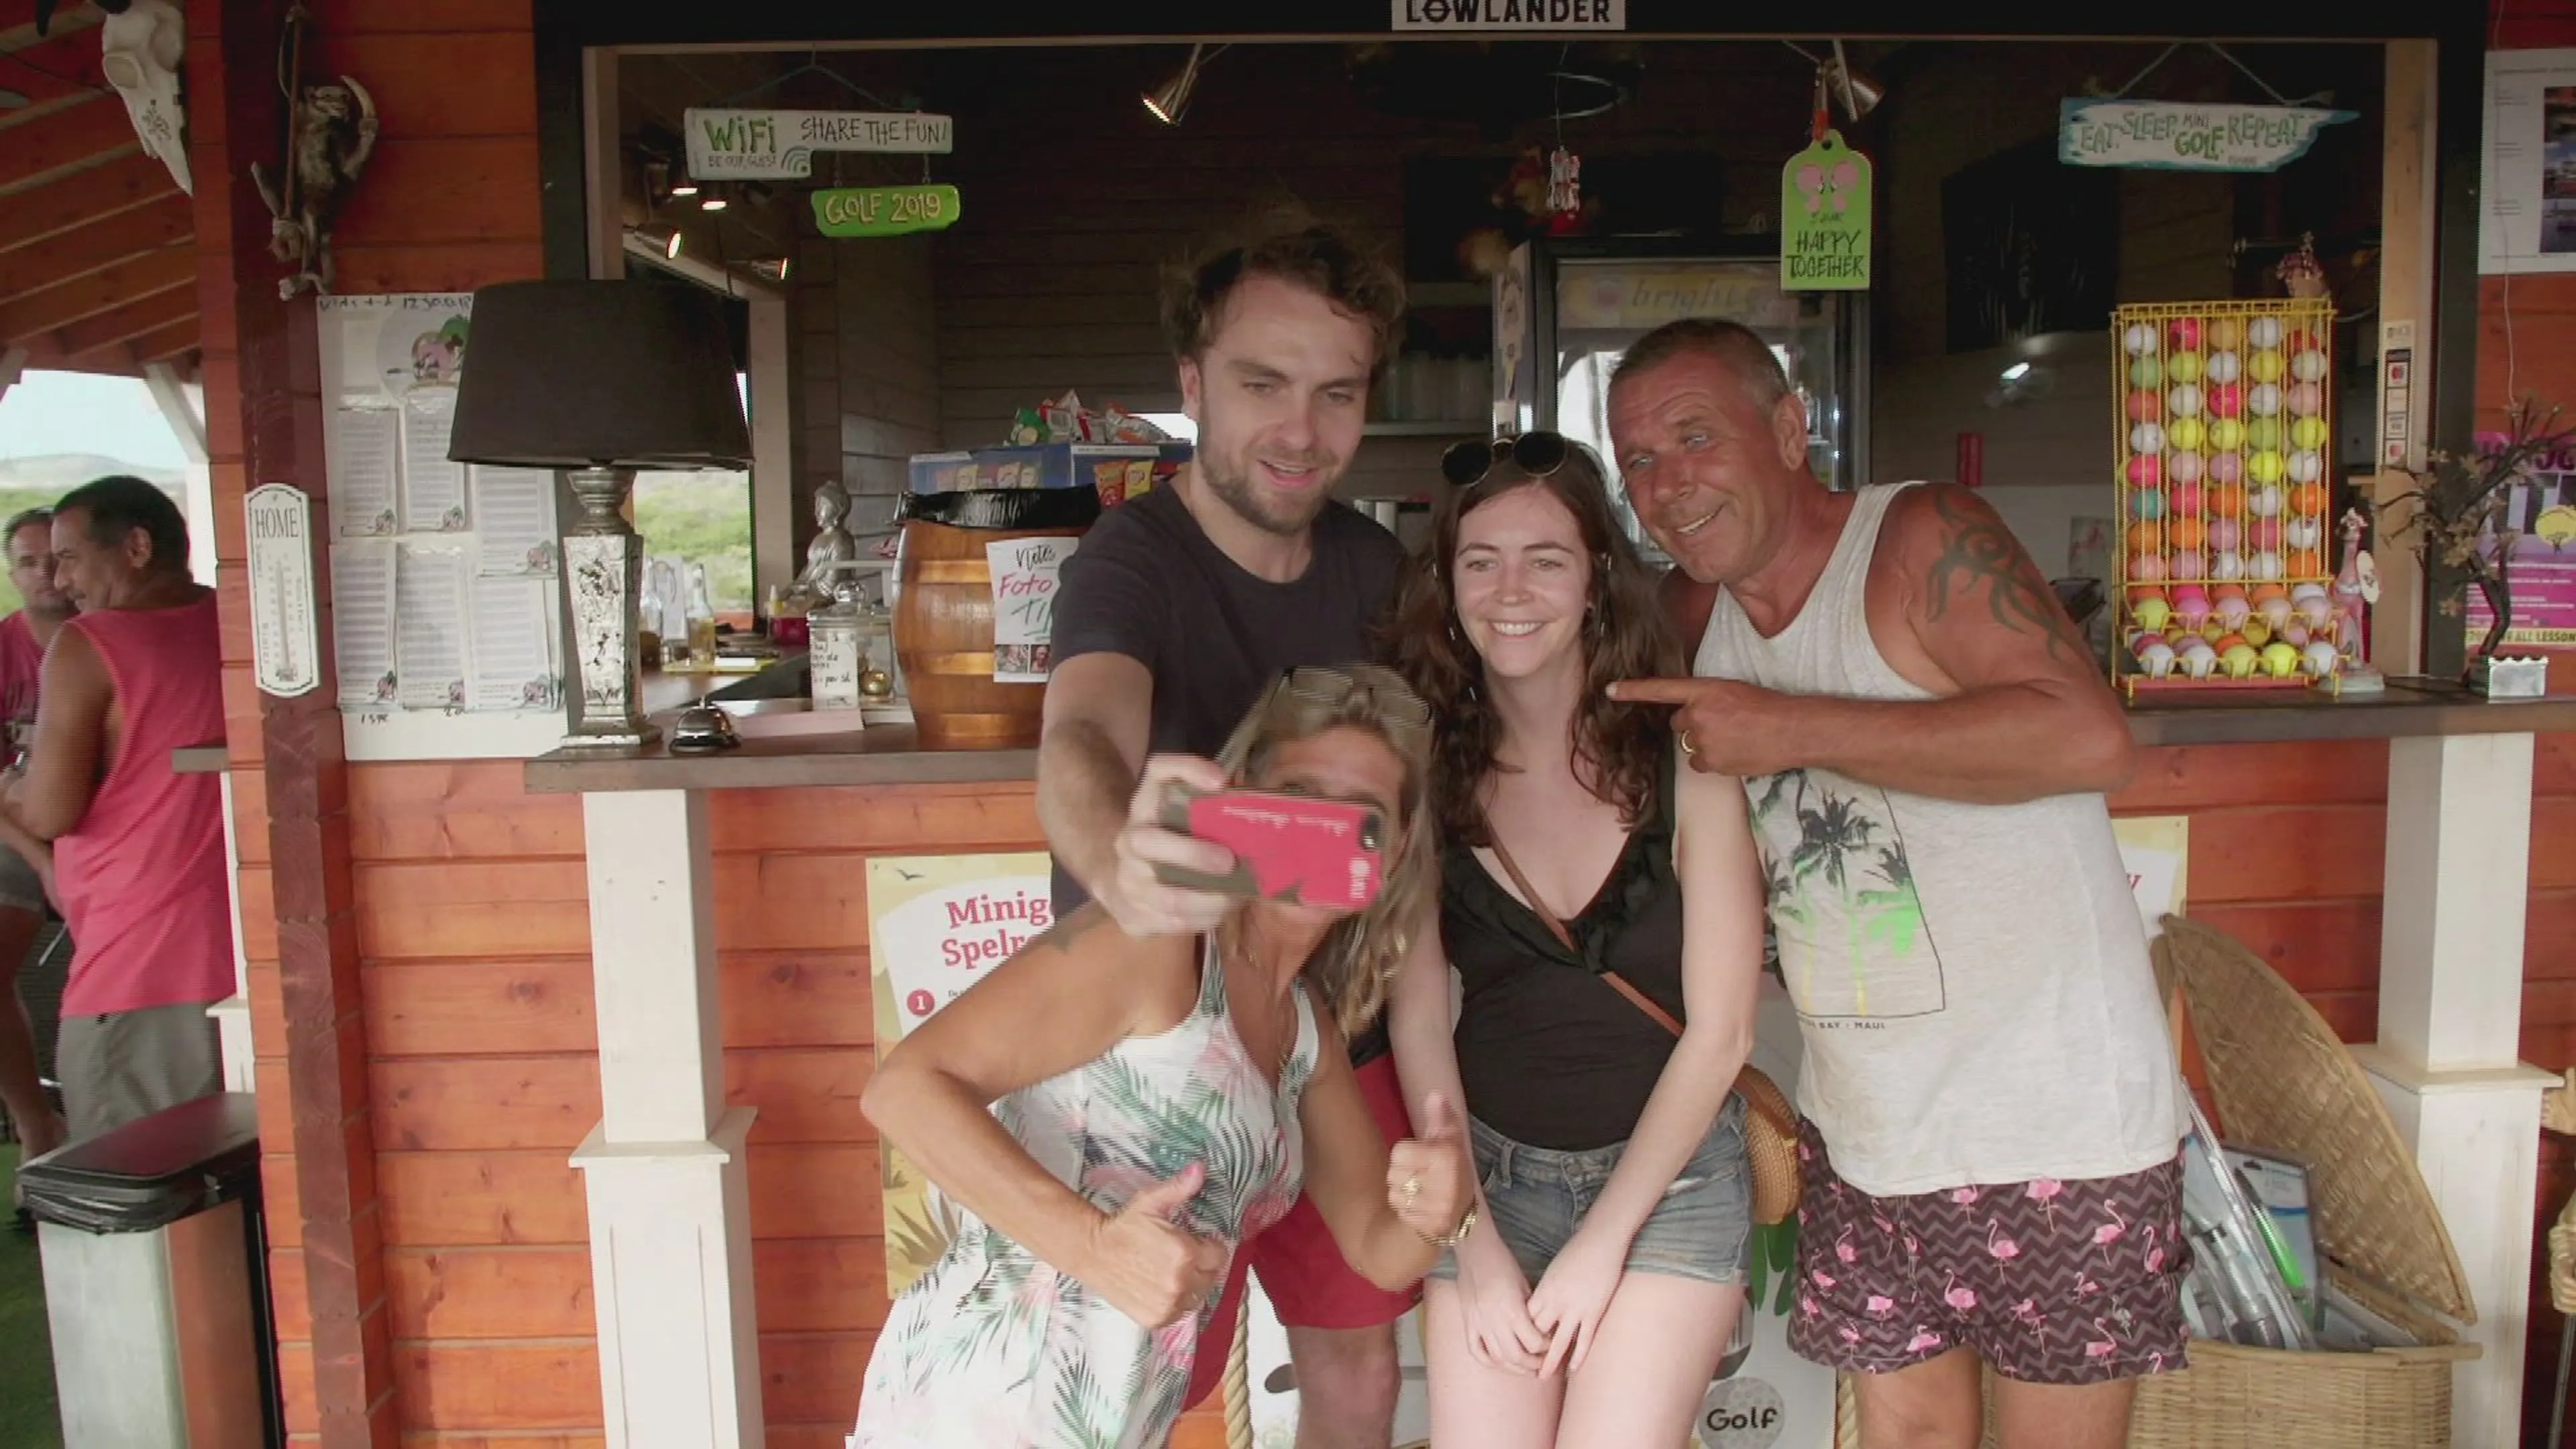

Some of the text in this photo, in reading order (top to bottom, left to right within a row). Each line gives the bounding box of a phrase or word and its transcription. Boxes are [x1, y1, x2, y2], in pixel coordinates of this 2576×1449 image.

[1406, 0, 1610, 23] LOWLANDER
[800, 117, 861, 143] SHARE
[864, 119, 901, 145] THE
[2227, 113, 2305, 148] REPEAT
[824, 193, 941, 225] GOLF 2019
[1794, 229, 1862, 254] HAPPY
[1785, 254, 1866, 279] TOGETHER
[254, 508, 299, 538] HOME
[999, 572, 1053, 599] Foto
[945, 890, 1049, 929] Minig
[941, 928, 1033, 970] Spelr
[916, 995, 926, 1011] 1
[1706, 1406, 1778, 1431] Golf
